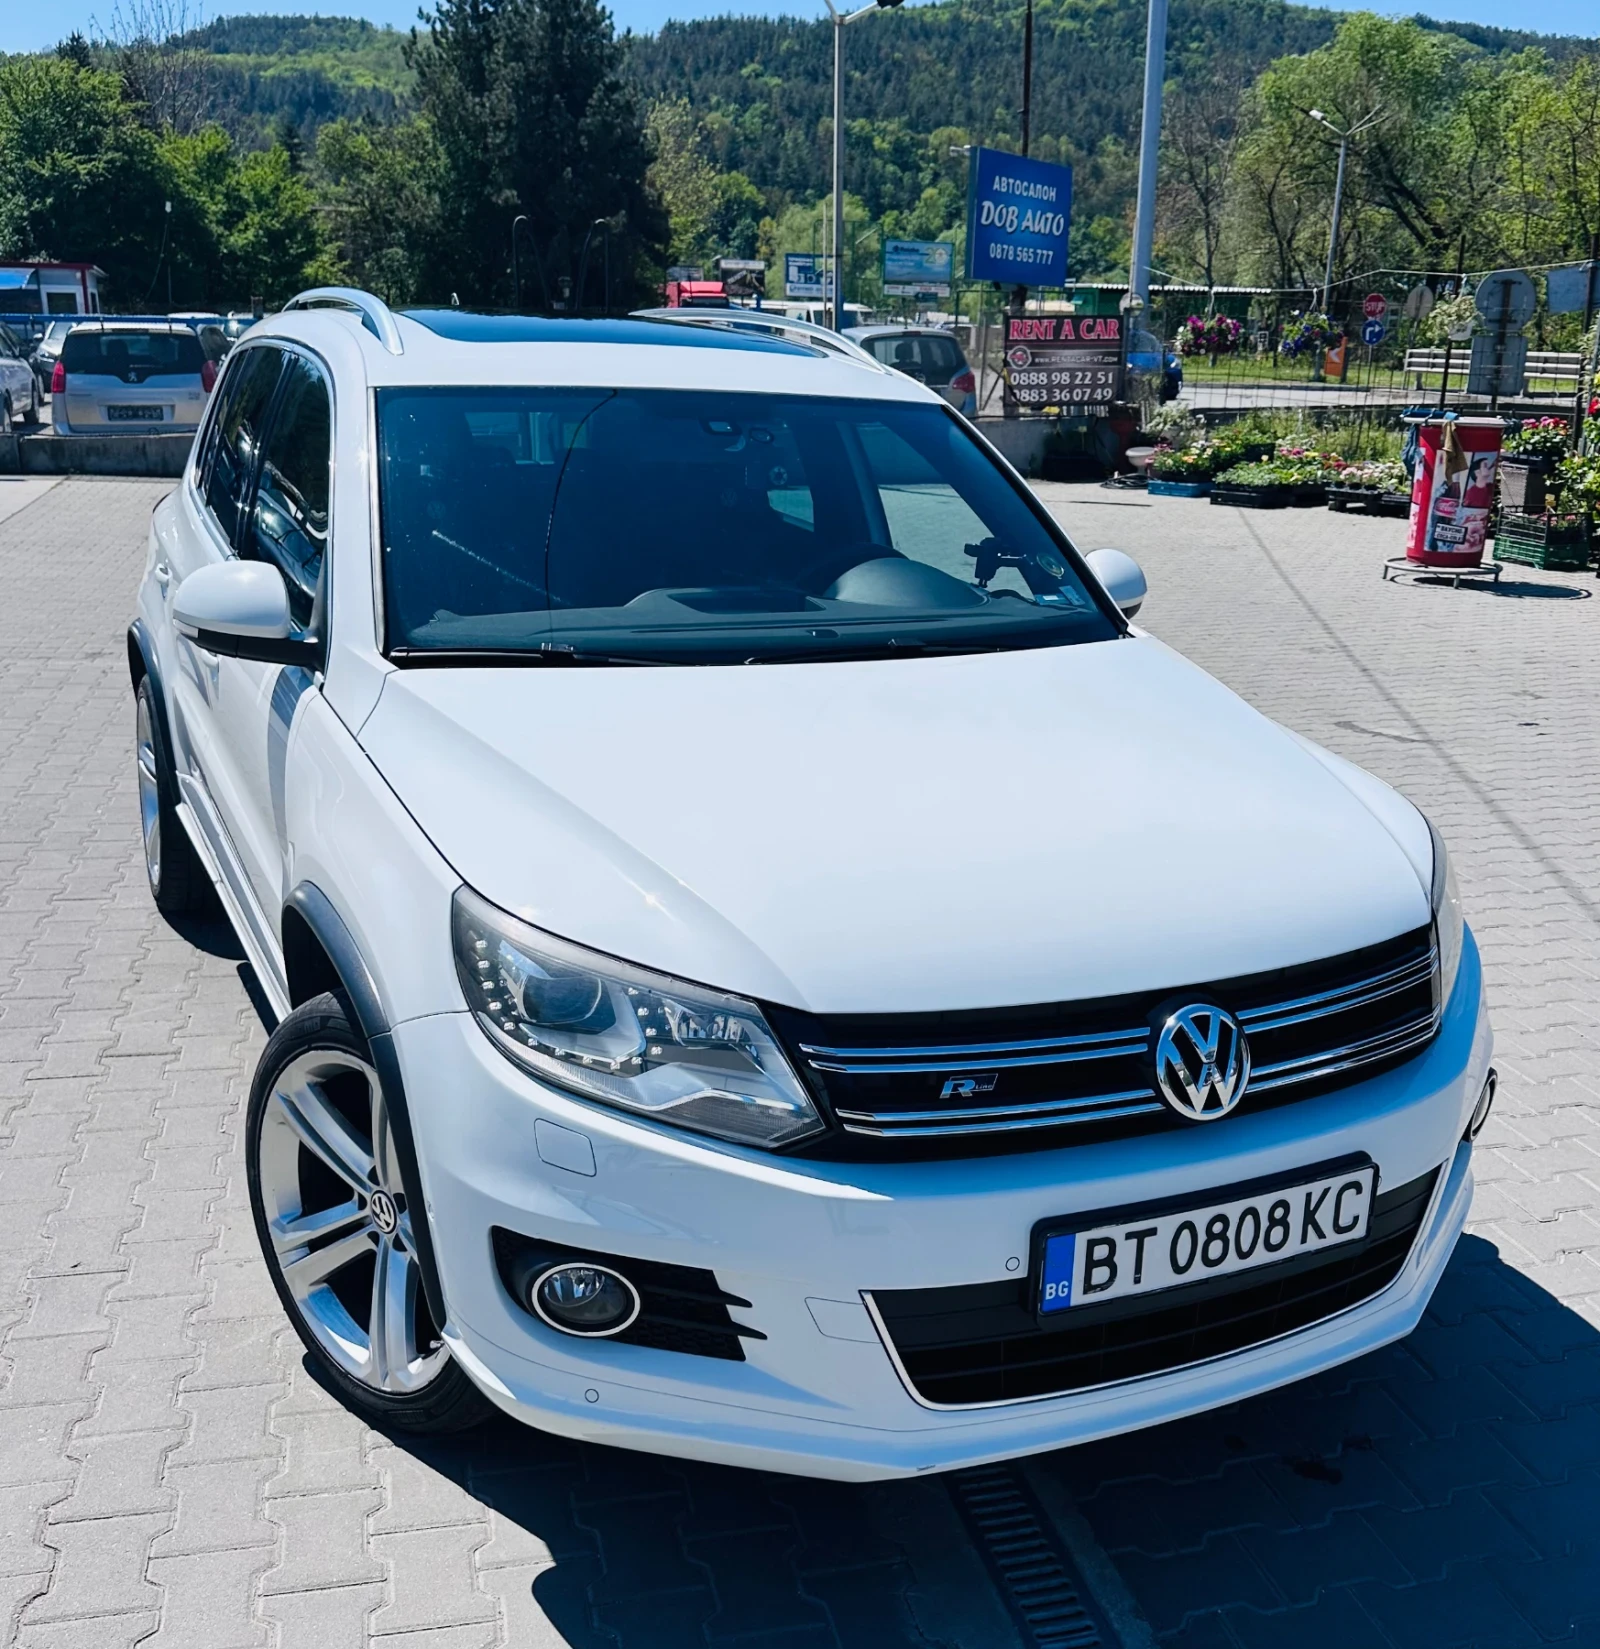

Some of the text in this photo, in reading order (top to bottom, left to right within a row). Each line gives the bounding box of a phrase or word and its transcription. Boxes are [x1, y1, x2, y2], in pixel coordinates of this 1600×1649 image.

[993, 175, 1057, 202] АВТОСАЛОН
[981, 200, 1065, 236] DOB AUTO
[990, 242, 1054, 266] 0878 565 777
[1009, 318, 1120, 340] RENT A CAR
[1010, 371, 1113, 385] 0888 98 22 51
[1052, 388, 1070, 401] 36
[1072, 388, 1091, 401] 07
[1092, 388, 1113, 401] 49
[1083, 1180, 1363, 1295] BT 0808 KC
[1045, 1280, 1069, 1300] BG
